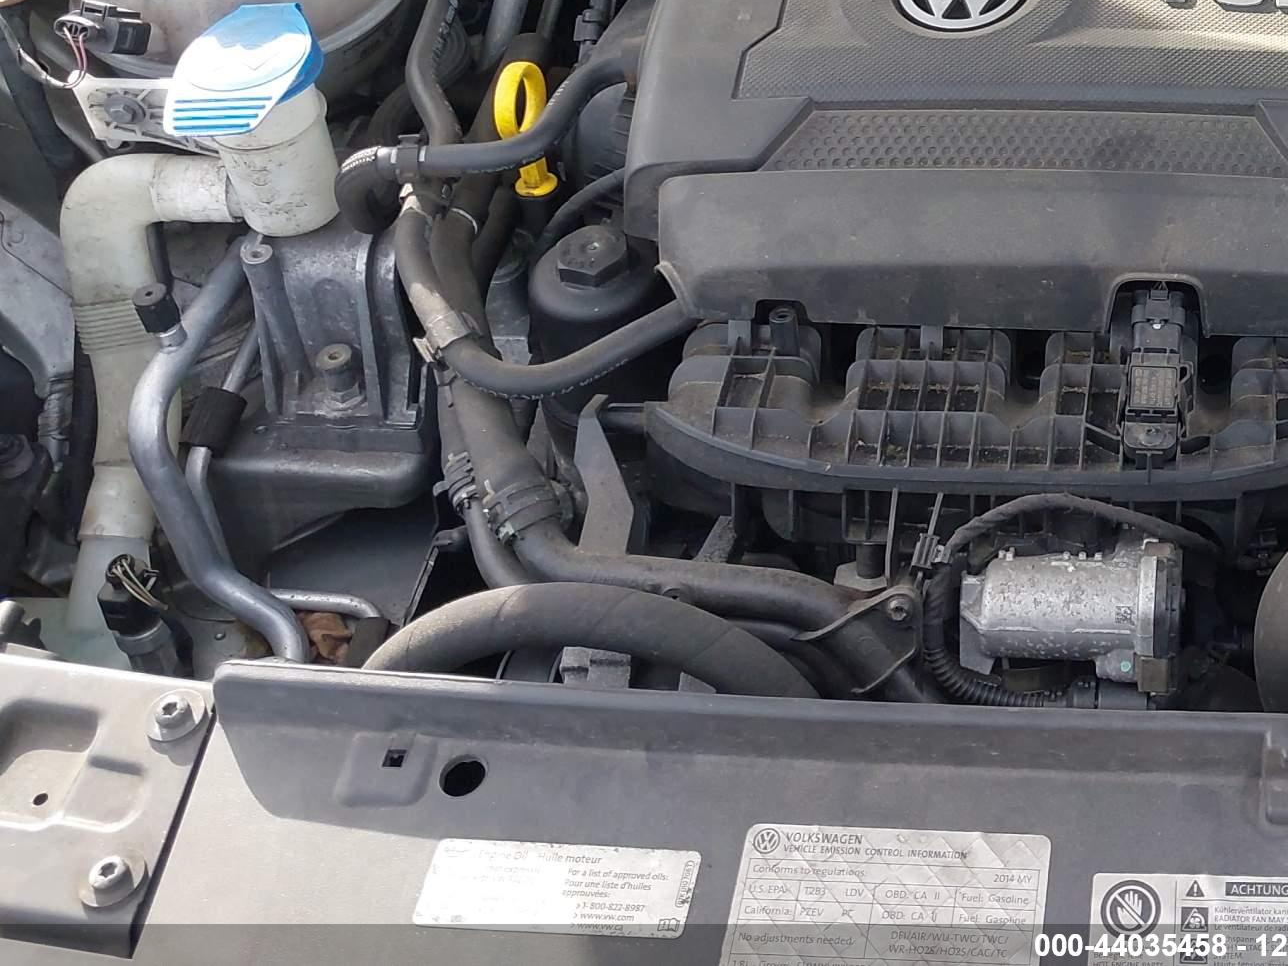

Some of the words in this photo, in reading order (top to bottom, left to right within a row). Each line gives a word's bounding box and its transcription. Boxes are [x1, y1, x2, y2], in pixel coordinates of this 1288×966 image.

[786, 832, 864, 845] VOLKSWAGEN
[784, 844, 817, 854] VEHICLE
[820, 846, 861, 856] EMISSION
[865, 848, 904, 858] CONTROL
[908, 849, 968, 860] INFORMATION
[565, 855, 602, 865] moteur
[568, 868, 582, 877] For
[589, 869, 601, 878] list
[603, 869, 613, 878] of
[613, 870, 650, 881] approved
[753, 864, 797, 875] Conforms
[800, 866, 811, 875] to
[994, 874, 1014, 883] 2014
[1017, 875, 1032, 883] MY
[584, 881, 600, 889] une
[601, 881, 619, 890] liste
[845, 888, 865, 897] LDV
[914, 891, 927, 900] CA
[961, 894, 983, 903] Fuel:
[988, 894, 1029, 905] Gasoline
[744, 906, 792, 916] California:
[911, 912, 924, 921] CA
[986, 915, 1026, 926] Gasoline
[1214, 914, 1251, 923] RADIATOR
[1252, 915, 1267, 923] FAN
[1268, 915, 1285, 923] MAY
[738, 932, 752, 941] No
[754, 933, 814, 945] adjustments
